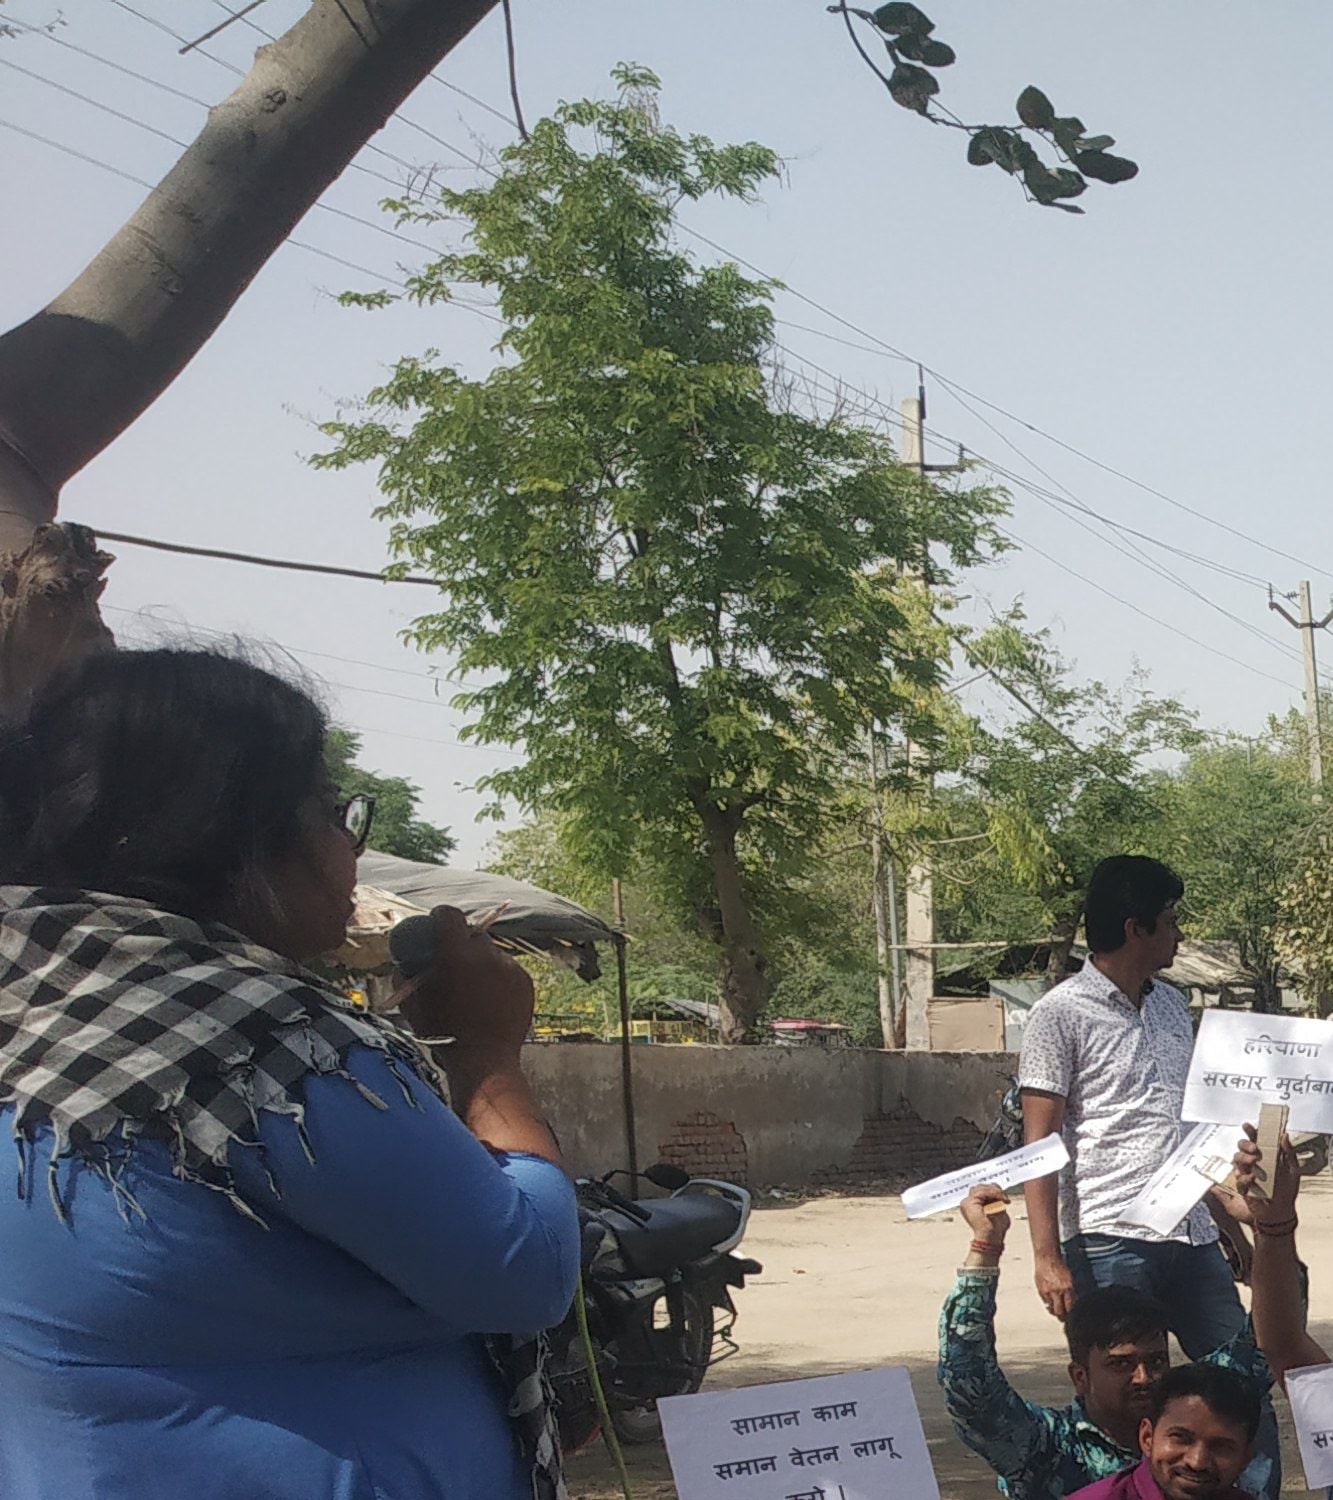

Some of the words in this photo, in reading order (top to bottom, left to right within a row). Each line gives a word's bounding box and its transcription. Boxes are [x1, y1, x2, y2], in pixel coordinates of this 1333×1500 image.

[1244, 1035, 1322, 1057] हरियाणा
[1203, 1071, 1267, 1091] सरकार
[731, 1410, 800, 1436] सामान
[812, 1401, 857, 1422] काम
[713, 1455, 777, 1480] समान
[789, 1446, 839, 1467] वेतन
[851, 1436, 902, 1460] लागू
